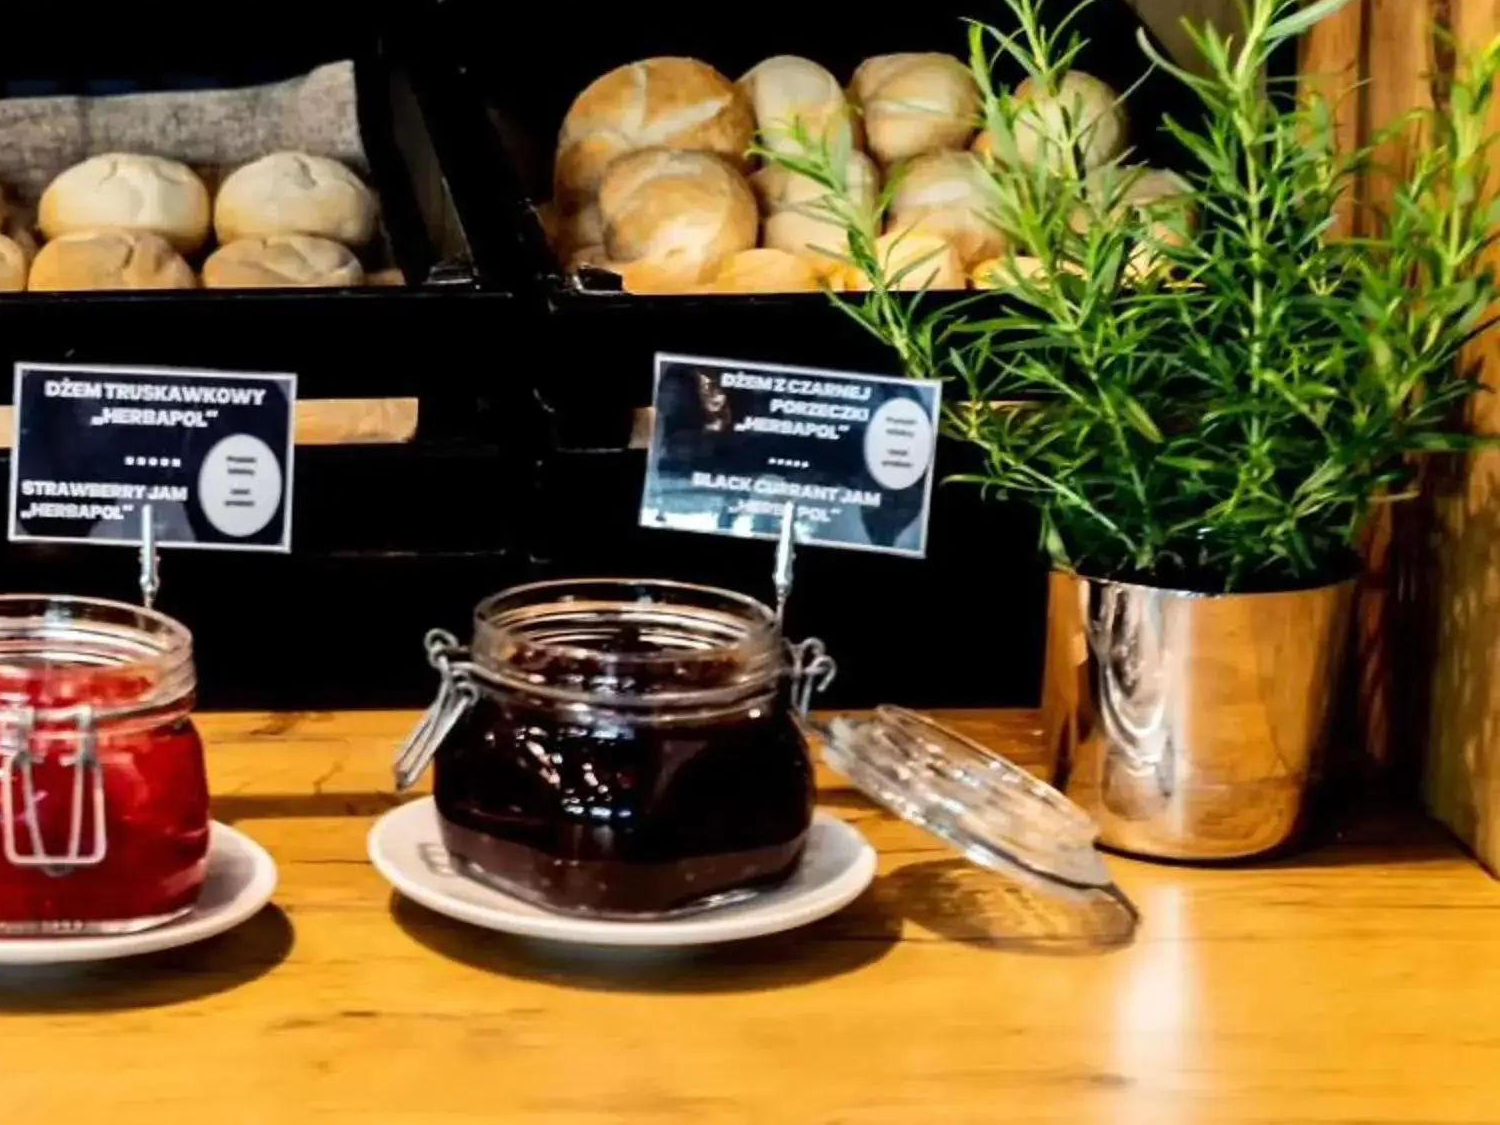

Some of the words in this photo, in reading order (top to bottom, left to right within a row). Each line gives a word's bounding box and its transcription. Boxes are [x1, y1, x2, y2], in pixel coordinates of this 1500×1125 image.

[44, 377, 103, 399] DŻEM
[103, 382, 266, 406] TRUSKAWKOWY
[773, 378, 787, 392] Z
[787, 379, 872, 401] CZARNEJ
[21, 479, 146, 499] STRAWBERRY
[147, 485, 188, 502] JAM
[691, 472, 752, 492] BLACK
[753, 477, 839, 501] CURRANT
[840, 489, 882, 508] JAM
